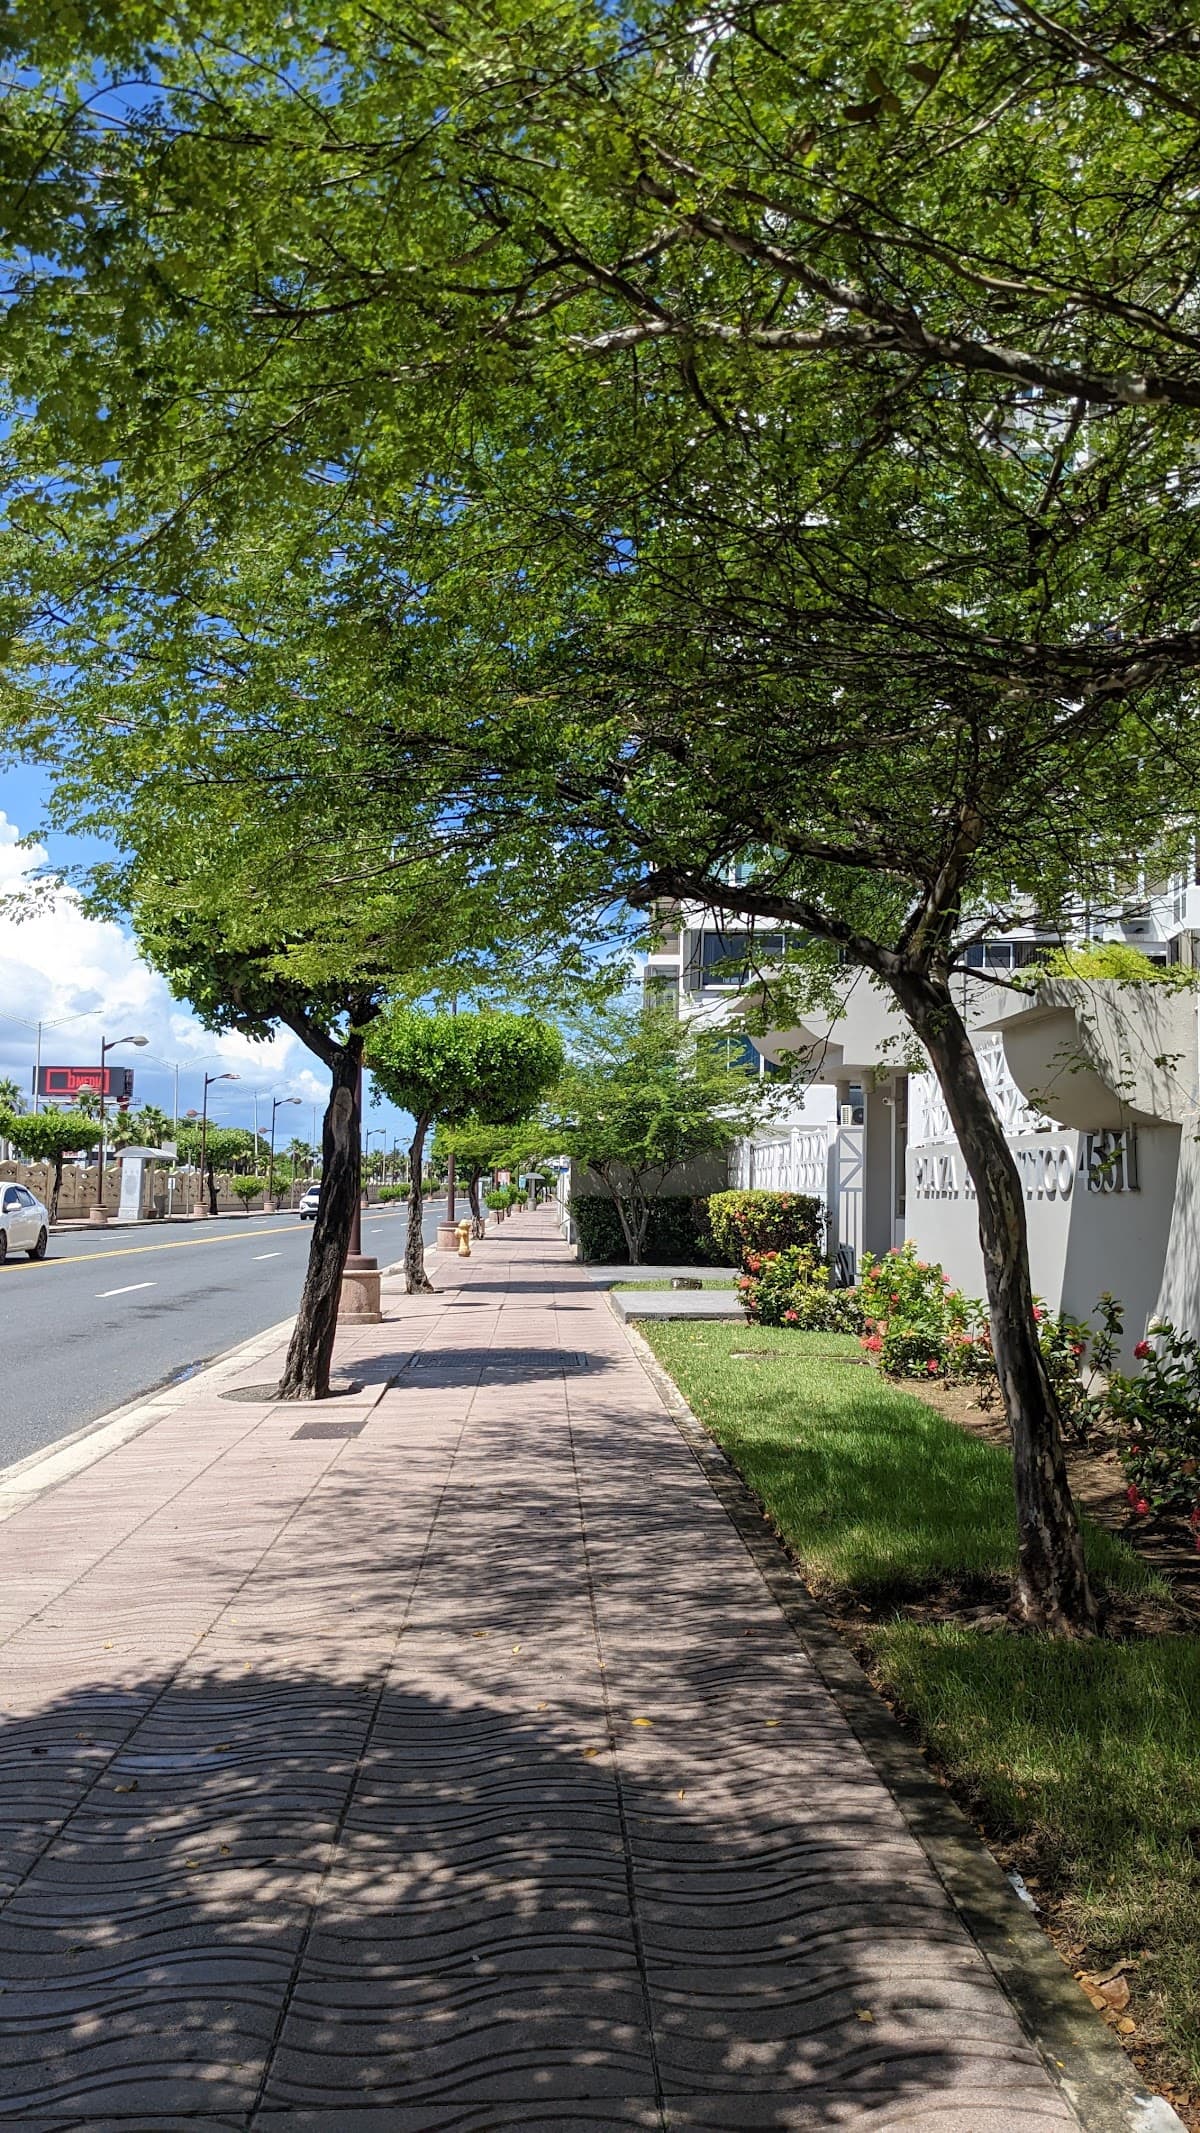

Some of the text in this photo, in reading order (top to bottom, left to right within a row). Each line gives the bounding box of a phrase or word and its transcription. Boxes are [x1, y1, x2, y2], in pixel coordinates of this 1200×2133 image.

[914, 1145, 1074, 1192] PLAZA ATICO
[1078, 1131, 1132, 1193] 4531
